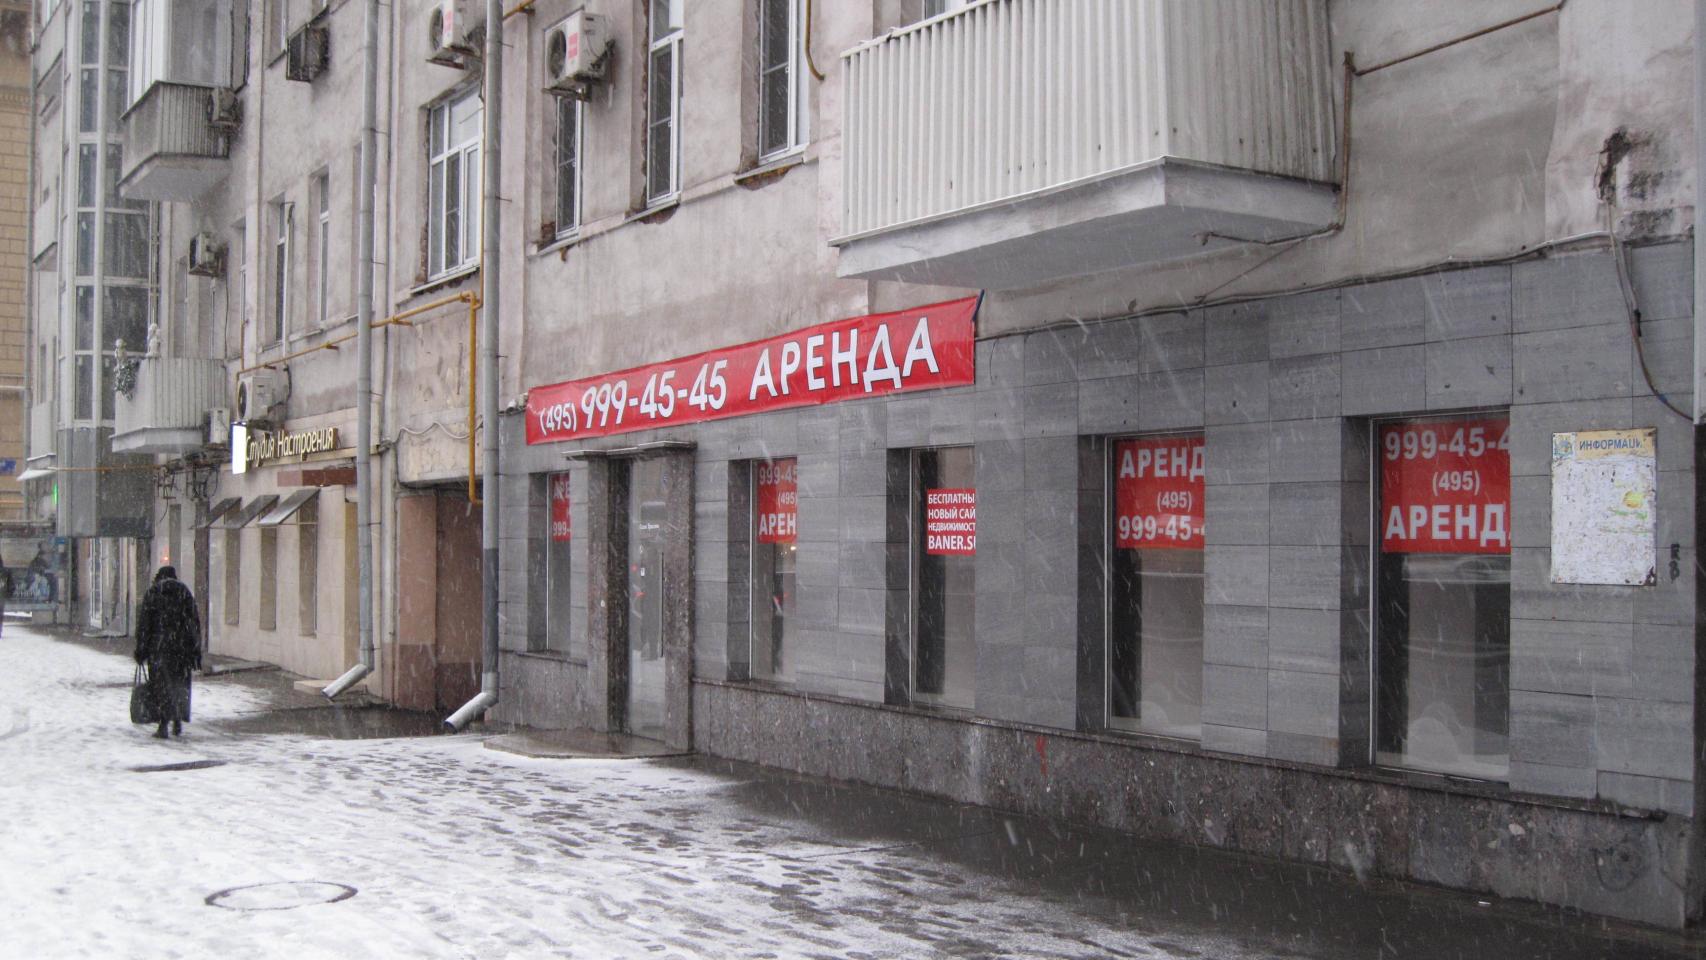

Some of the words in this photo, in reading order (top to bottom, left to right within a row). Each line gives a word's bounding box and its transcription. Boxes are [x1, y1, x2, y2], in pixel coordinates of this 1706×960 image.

[540, 403, 577, 436] (495)
[581, 360, 727, 429] 999-45-45
[749, 317, 939, 400] АРЕНДА
[277, 427, 334, 461] Настроения
[1432, 469, 1480, 497] (495)
[928, 507, 957, 519] НОВЫЙ
[1157, 491, 1192, 513] (495)
[1385, 504, 1511, 547] АРЕНД
